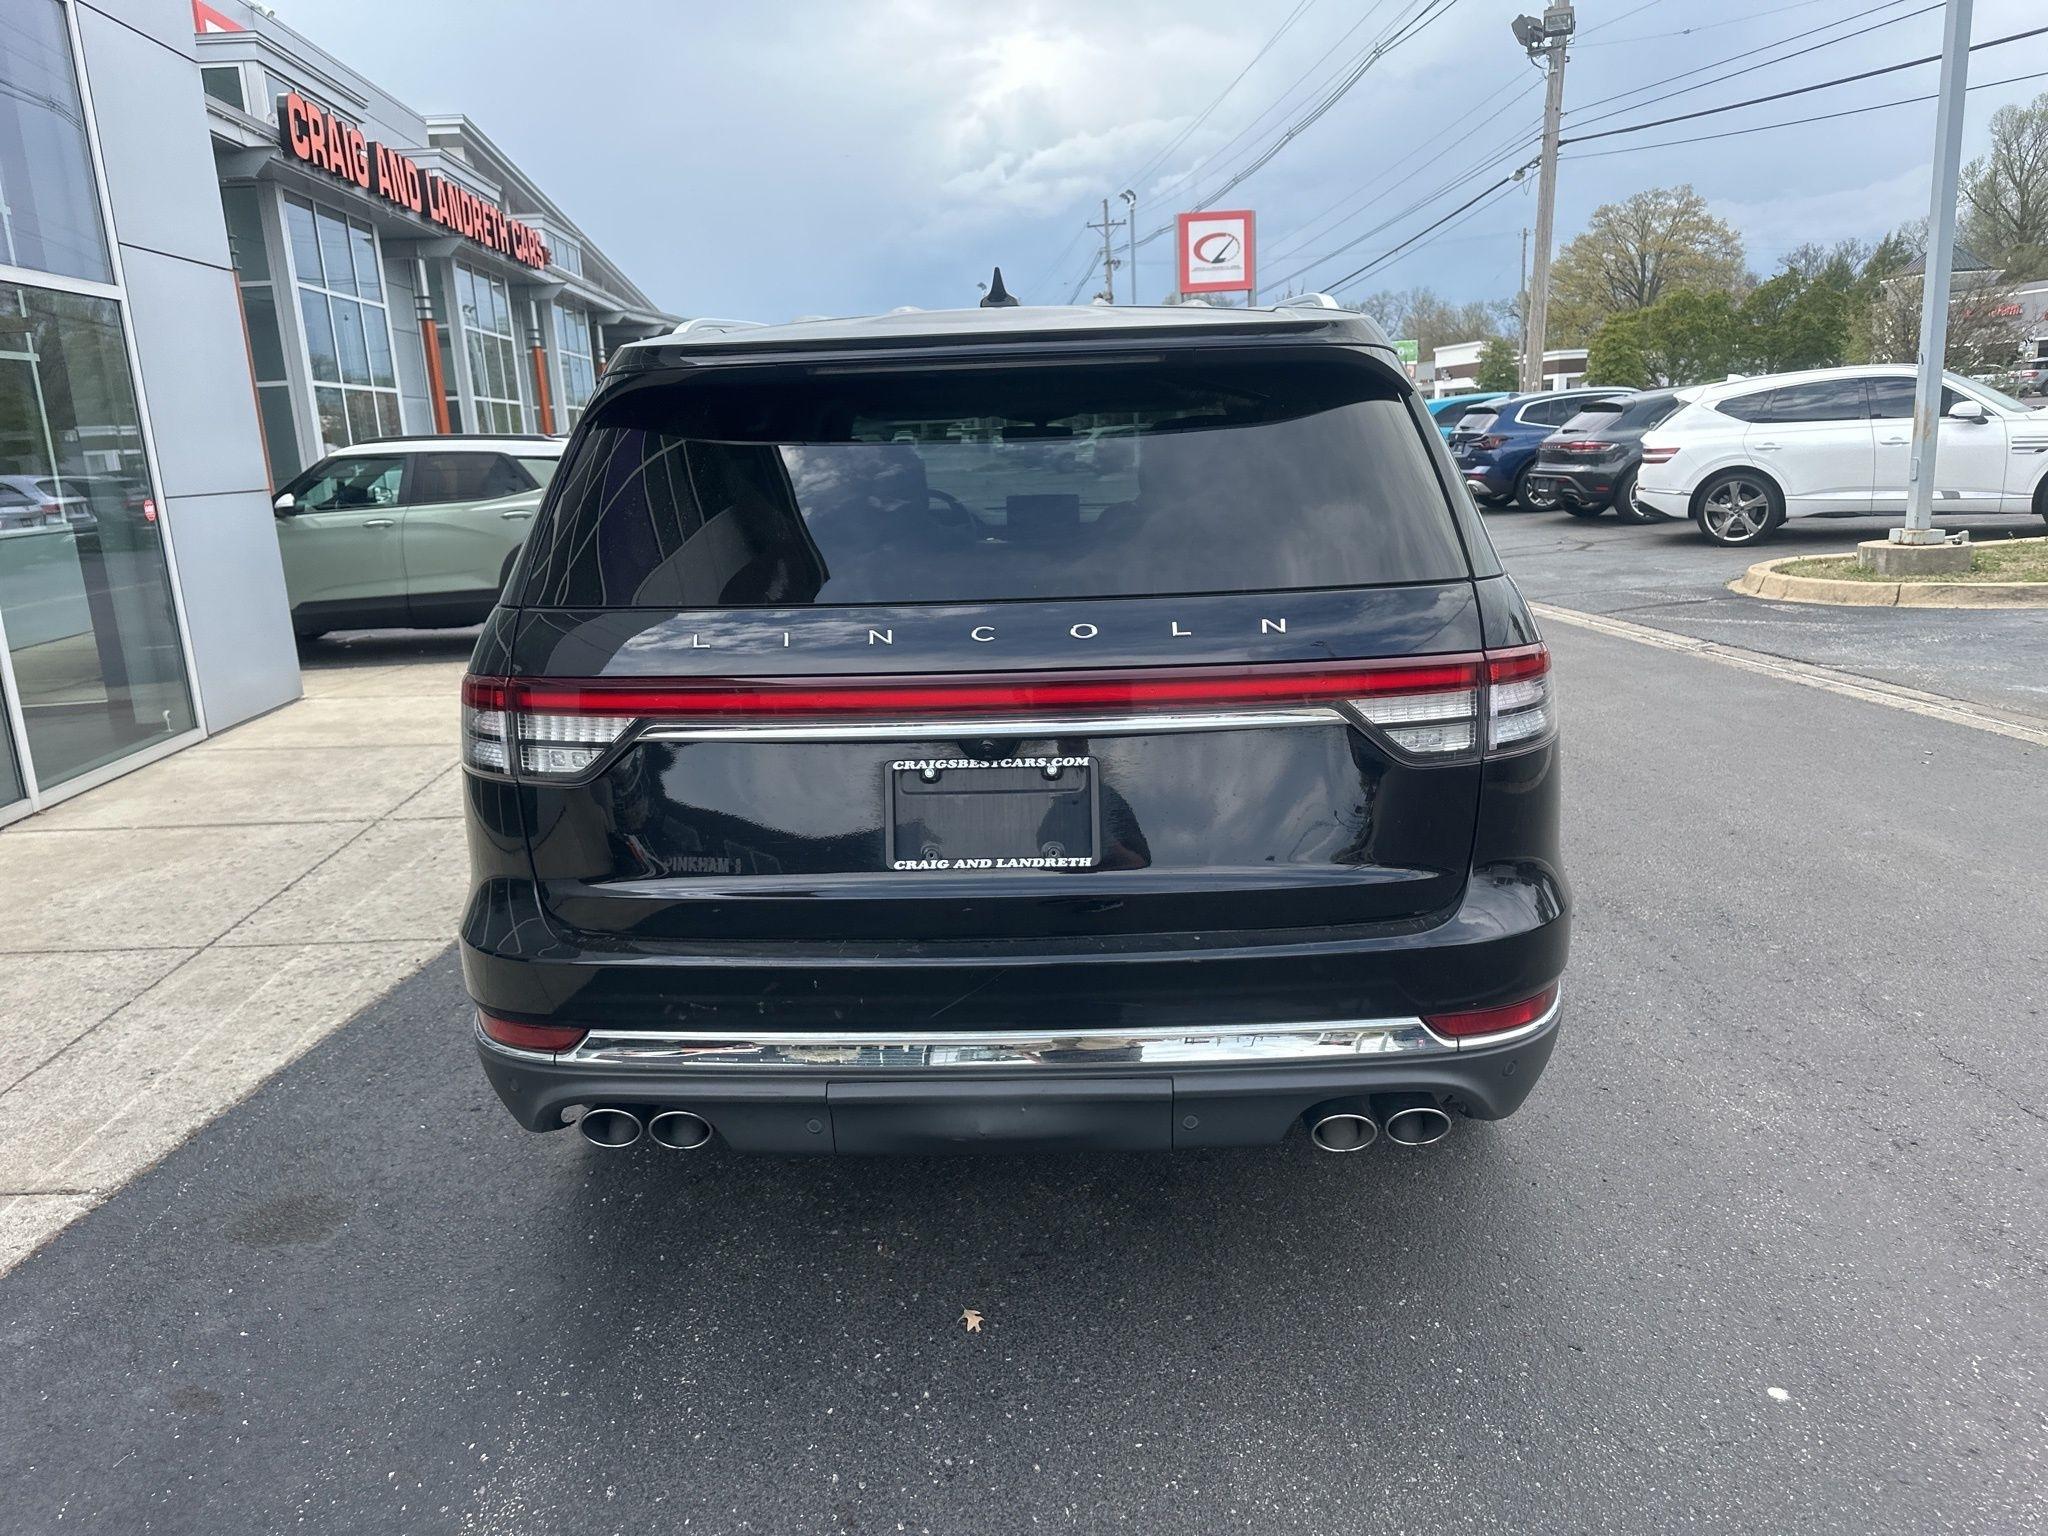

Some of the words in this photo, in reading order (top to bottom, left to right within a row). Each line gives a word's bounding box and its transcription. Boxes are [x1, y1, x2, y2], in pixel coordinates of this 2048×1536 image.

[287, 91, 369, 189] CRAIG
[375, 141, 422, 213] AND
[425, 169, 511, 255] LANDRETH
[511, 218, 545, 271] CARS
[692, 617, 1288, 650] LINCOLN
[892, 756, 1090, 770] CRAIGSBESTCARS.COM
[893, 859, 950, 870] CRAIG
[953, 858, 993, 869] AND
[996, 857, 1093, 869] LANDRETH
